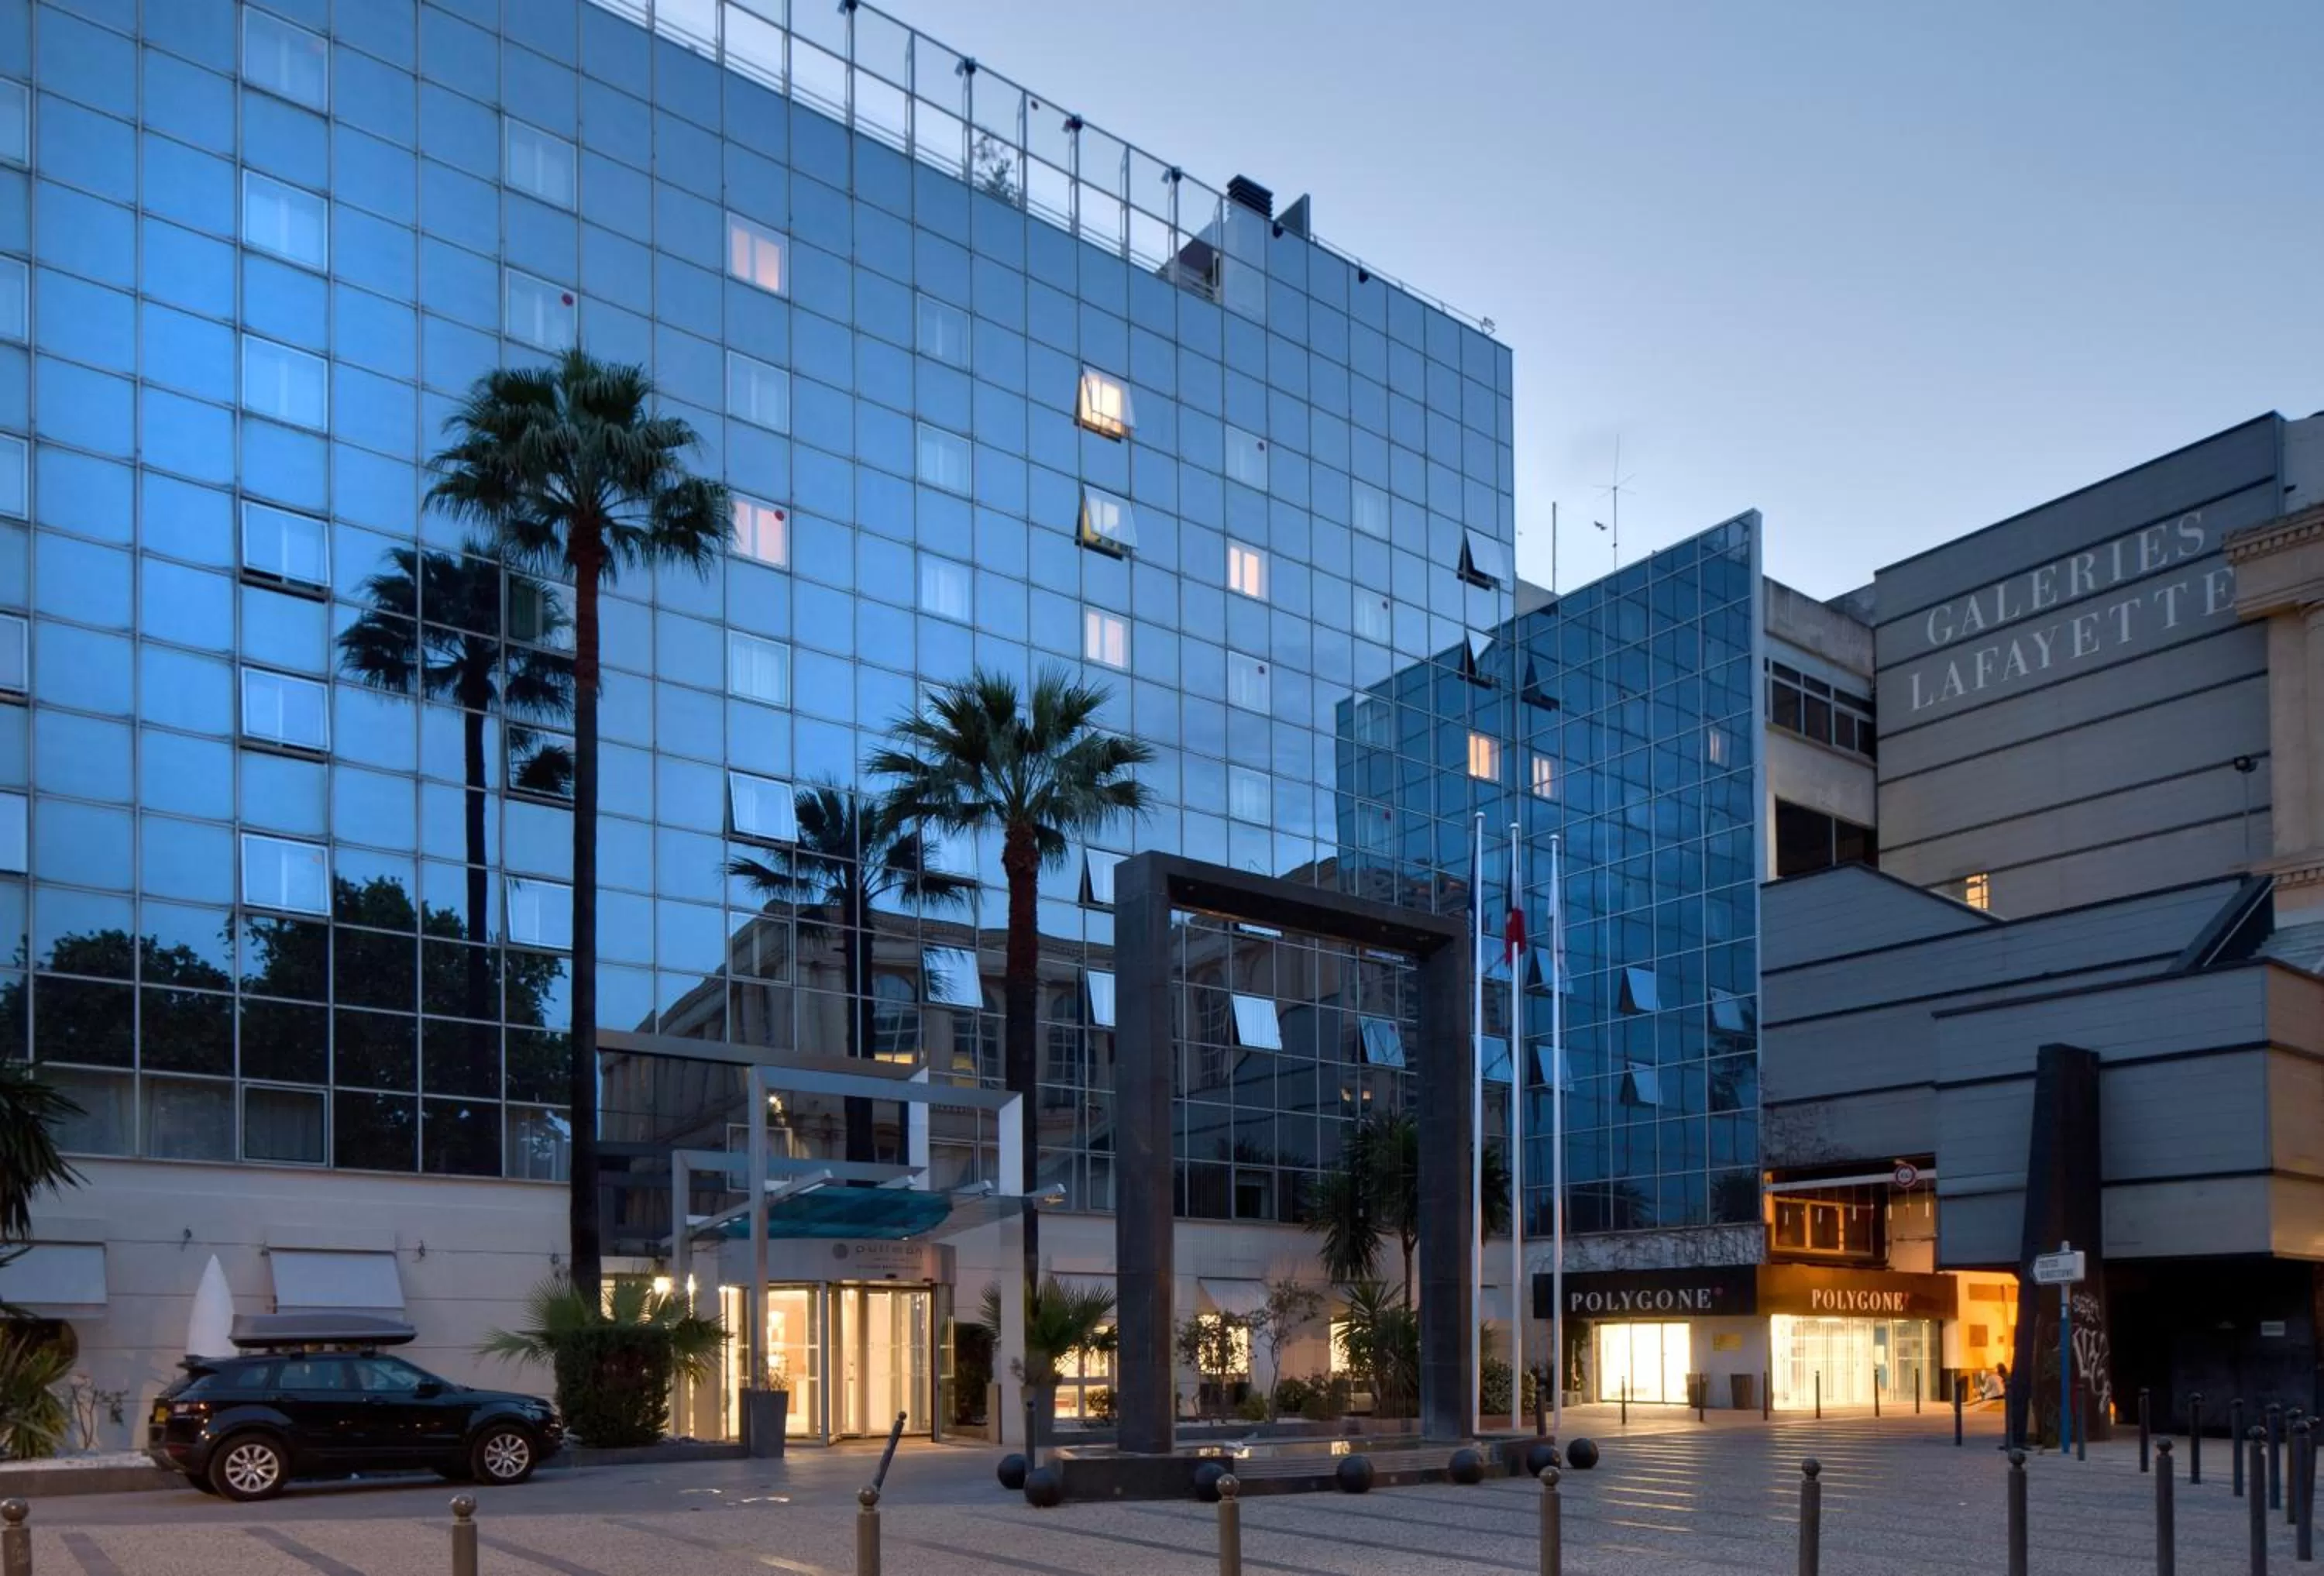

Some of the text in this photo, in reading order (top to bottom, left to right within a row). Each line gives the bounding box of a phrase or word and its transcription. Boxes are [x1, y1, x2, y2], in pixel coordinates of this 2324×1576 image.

[1927, 511, 2205, 645] GALERIES
[1908, 566, 2235, 711] LAFAYETTE
[1570, 1289, 1712, 1313] POLYGONE
[1812, 1289, 1903, 1312] POLYGONE
